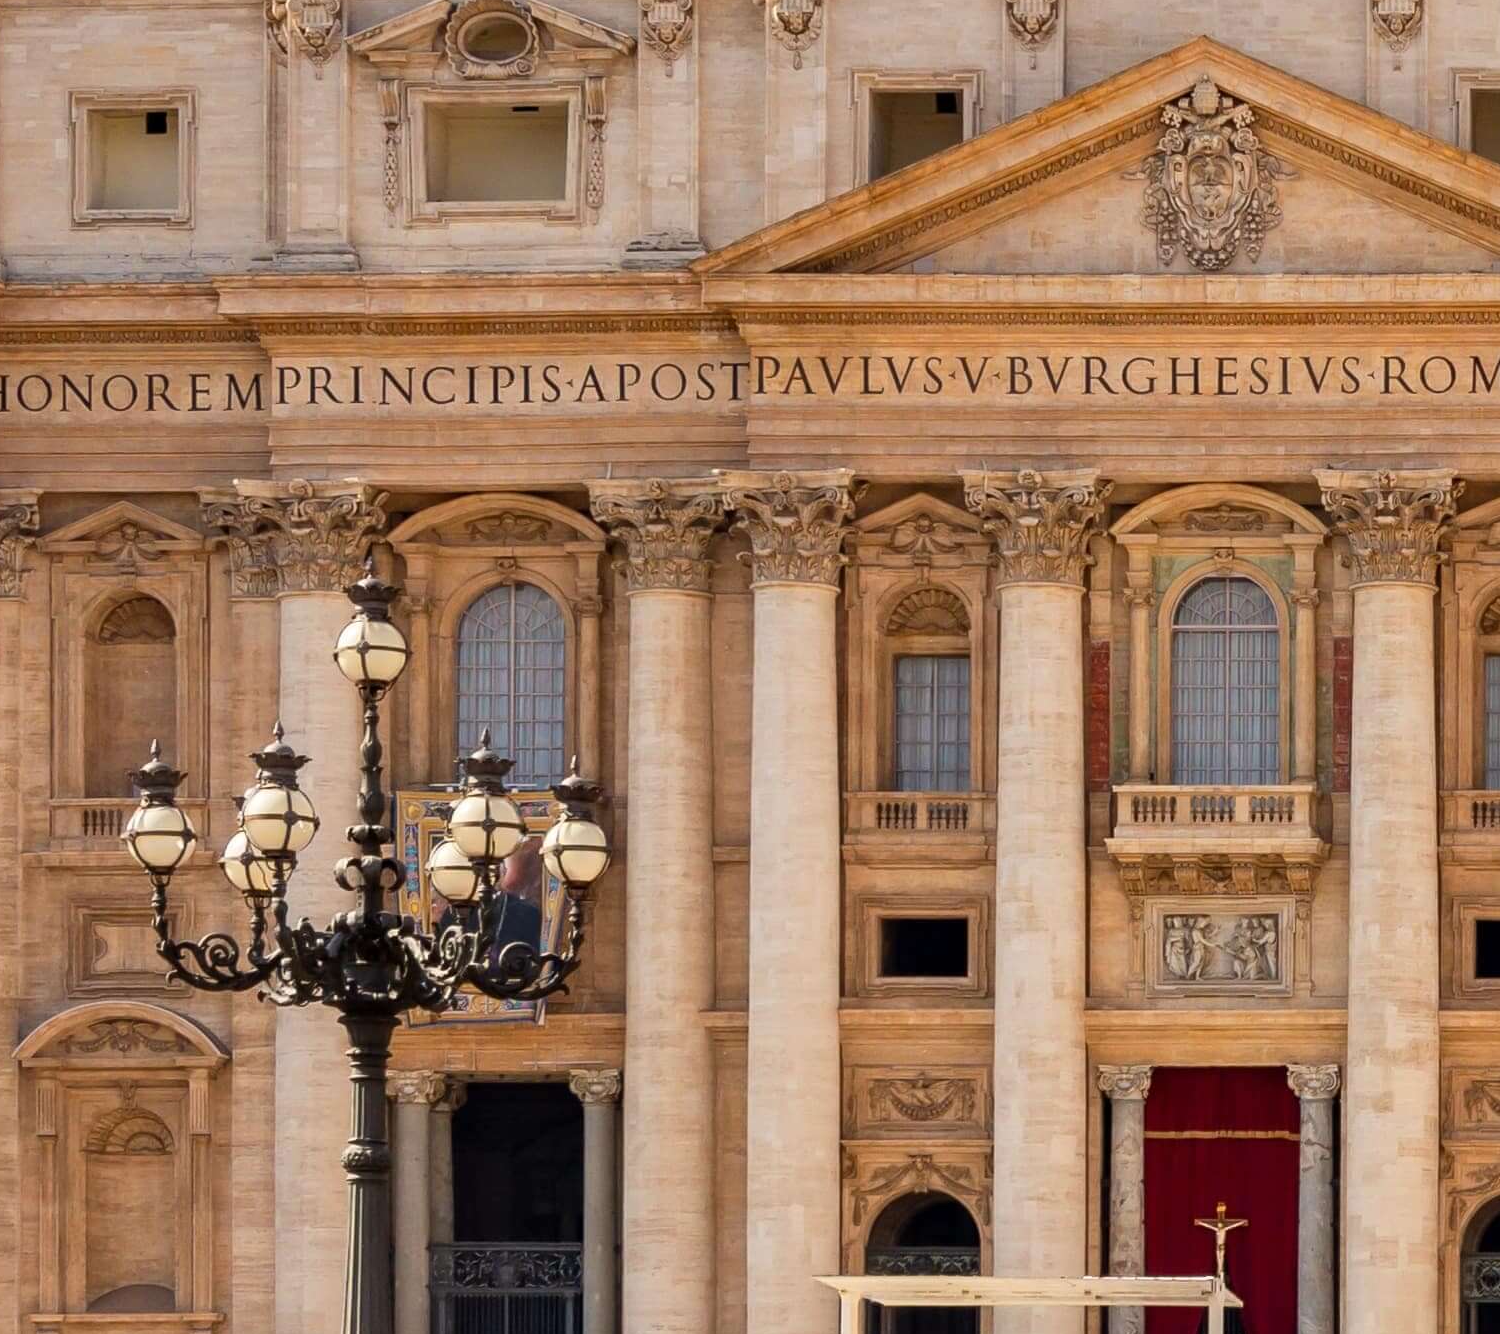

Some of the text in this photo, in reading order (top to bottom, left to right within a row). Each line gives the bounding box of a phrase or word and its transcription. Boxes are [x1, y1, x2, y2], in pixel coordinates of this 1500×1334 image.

[275, 364, 561, 405] PRINCIPIS
[575, 361, 751, 402] APOST
[754, 355, 943, 395] PAVLVS
[958, 356, 989, 393] V
[1006, 355, 1360, 396] BVRGHESIVS
